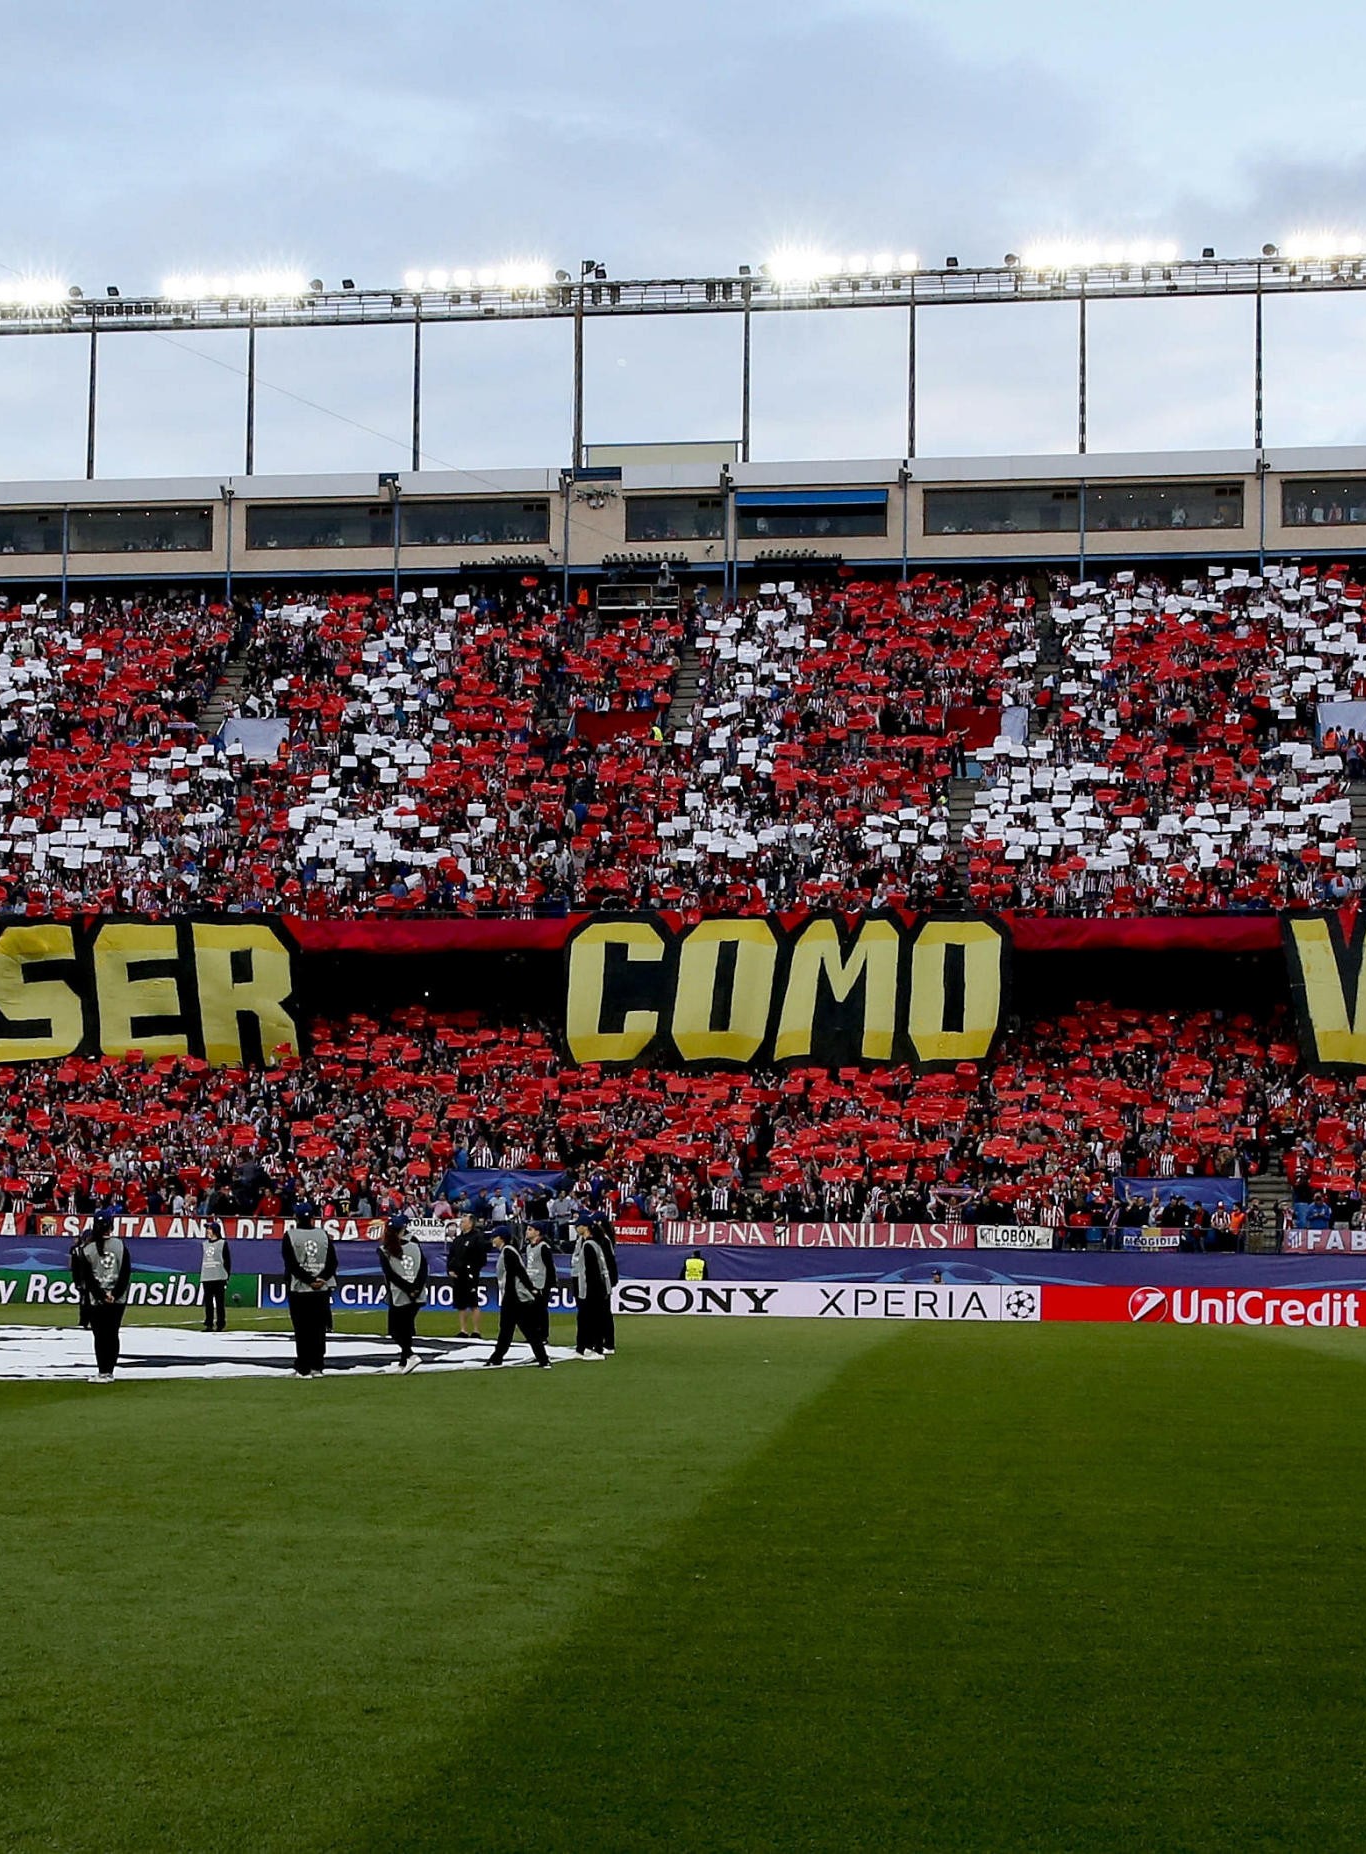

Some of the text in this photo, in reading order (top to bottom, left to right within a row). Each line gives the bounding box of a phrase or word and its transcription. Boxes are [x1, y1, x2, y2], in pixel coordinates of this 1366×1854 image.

[567, 919, 1003, 1065] COMO
[236, 1219, 275, 1239] DE
[284, 1219, 359, 1240] PSA
[797, 1224, 949, 1248] CANILLAS
[618, 1285, 988, 1318] SONY XPERIA
[1172, 1289, 1360, 1327] UniCredit
